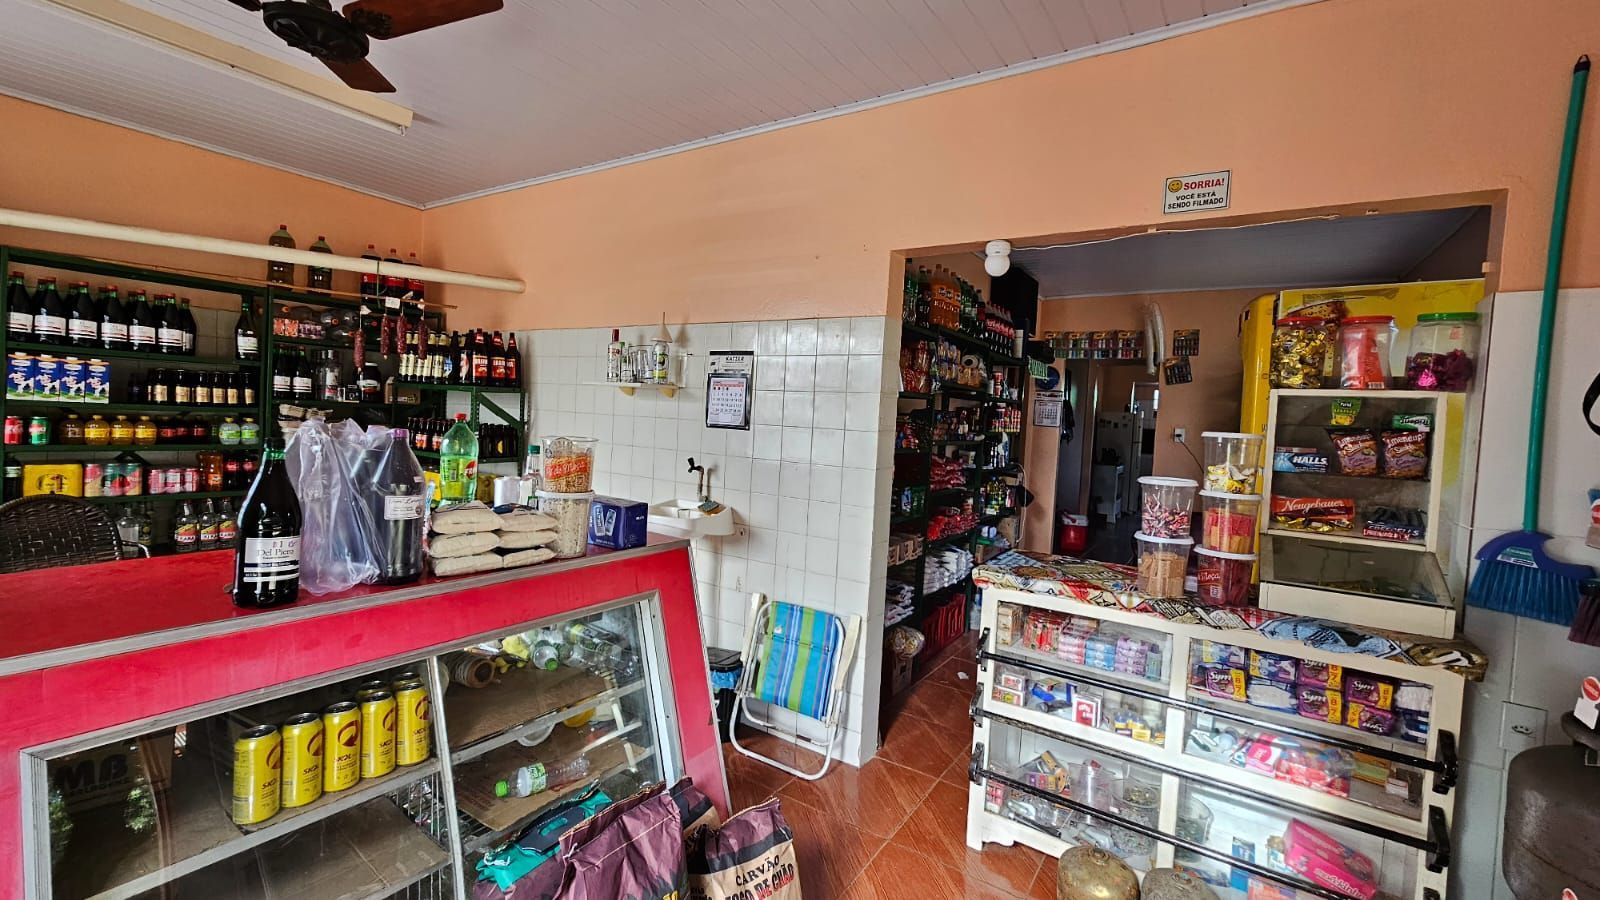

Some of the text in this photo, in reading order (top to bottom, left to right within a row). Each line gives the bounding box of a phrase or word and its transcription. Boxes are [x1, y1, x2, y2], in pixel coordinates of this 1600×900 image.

[1183, 178, 1225, 191] SORRIA!
[1176, 192, 1195, 200] VOCÊ
[1168, 197, 1223, 209] SENDO FILMADO
[1293, 455, 1328, 464] HALLS
[1280, 498, 1345, 514] Neugebauer
[735, 854, 780, 886] CARVÃO
[771, 863, 795, 891] CHÃO
